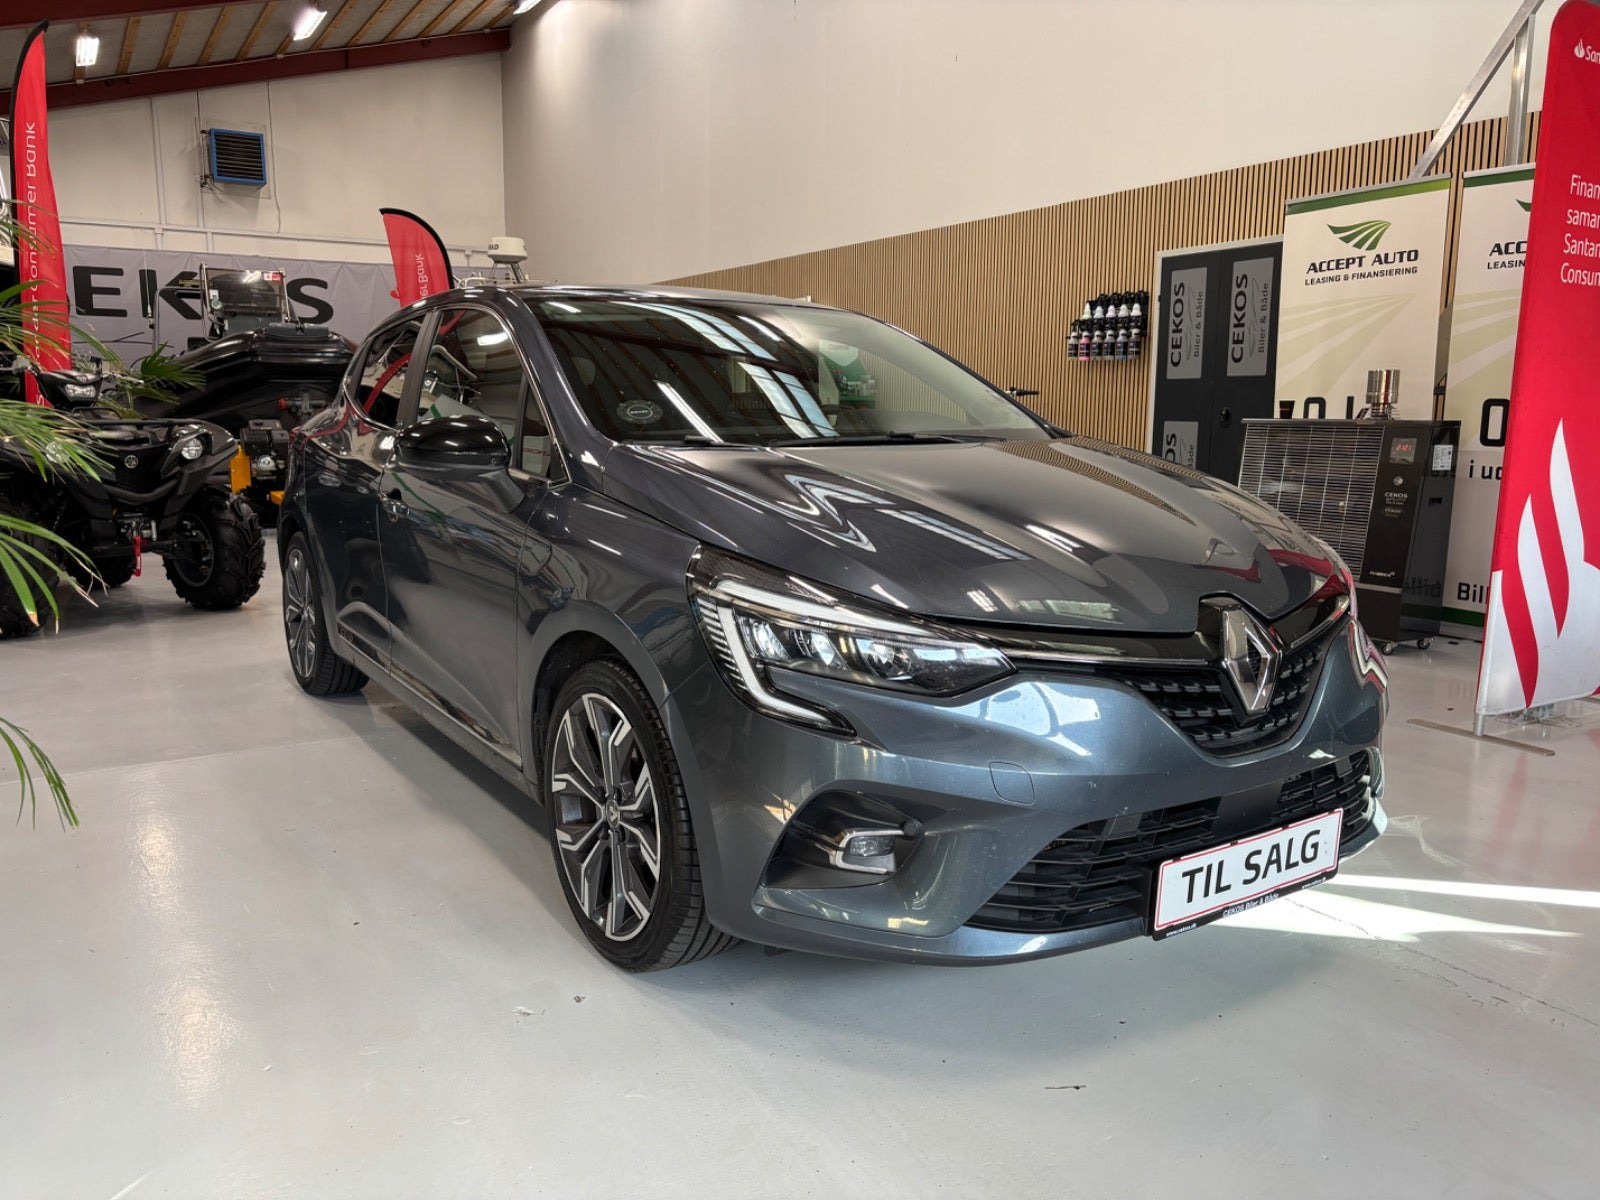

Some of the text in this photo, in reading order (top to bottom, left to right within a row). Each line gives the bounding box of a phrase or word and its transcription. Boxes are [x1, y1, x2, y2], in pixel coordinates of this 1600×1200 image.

[26, 121, 37, 177] Bank
[1304, 266, 1419, 287] LEASING & FINANSIERING
[1306, 249, 1419, 275] ACCEPT AUTO
[1170, 281, 1185, 368] CEKOS
[1231, 273, 1248, 364] CEKOS
[1257, 282, 1270, 353] Biler & Både
[1182, 829, 1321, 904] TIL SALG
